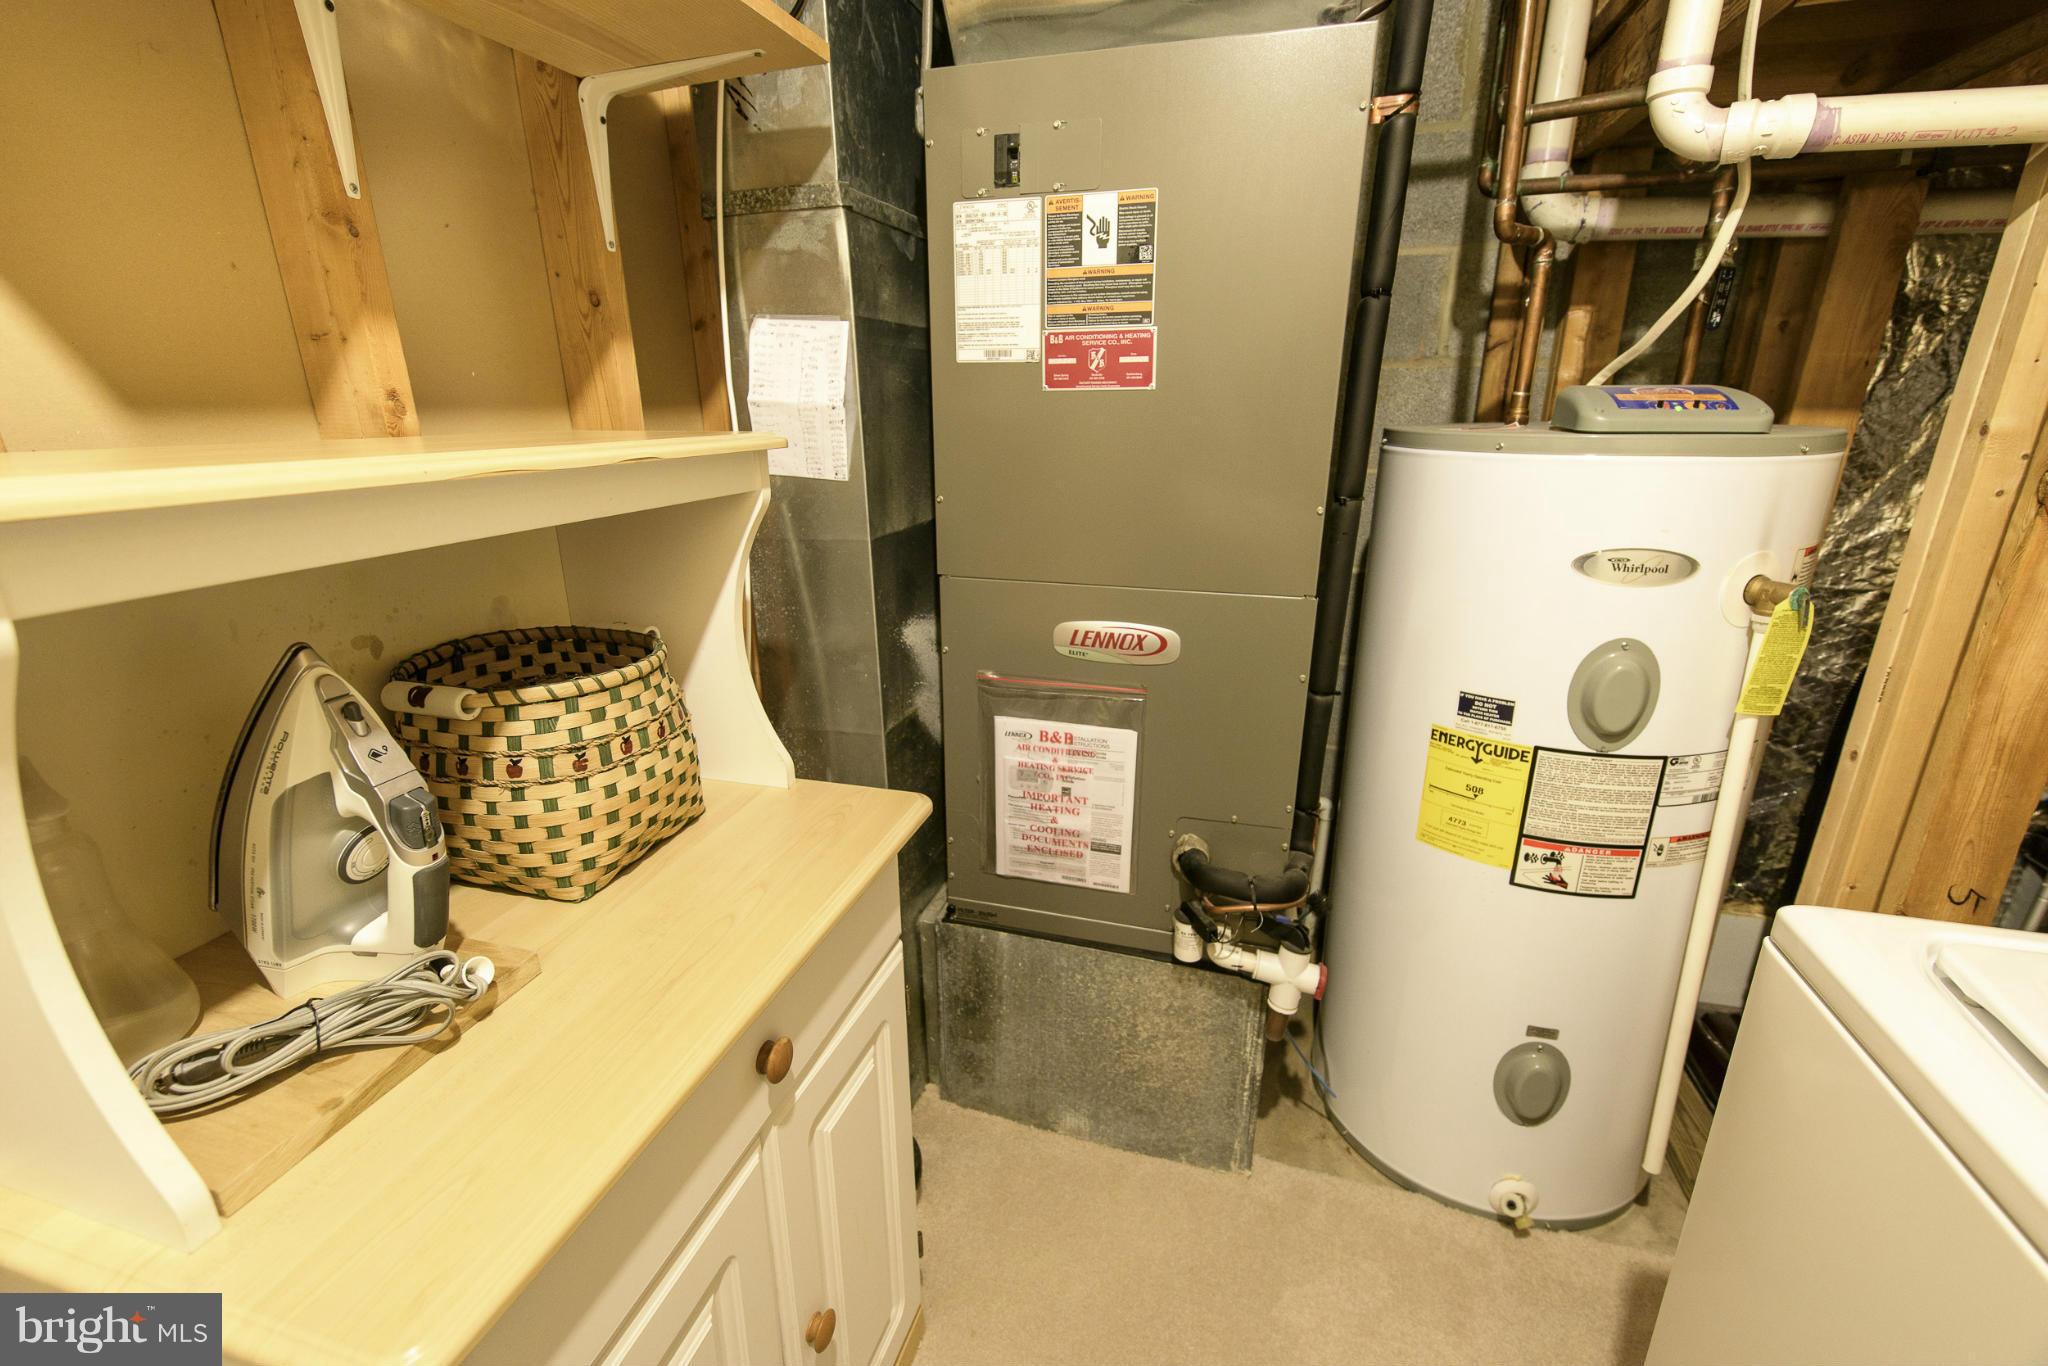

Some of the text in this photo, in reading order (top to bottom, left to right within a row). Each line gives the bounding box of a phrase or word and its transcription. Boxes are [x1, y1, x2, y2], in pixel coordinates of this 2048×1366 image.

[1842, 133, 1871, 145] ASTM
[1125, 193, 1155, 201] WARNING
[1088, 267, 1115, 275] WARNING
[1075, 333, 1118, 341] CONDITIONING
[1611, 562, 1670, 576] Whirlpool
[1069, 628, 1148, 652] LENNOX
[1484, 702, 1497, 710] NOT
[1040, 730, 1073, 746] B&B
[1016, 743, 1031, 752] AIR
[1430, 728, 1531, 764] ENERGYGUIDE
[1018, 761, 1055, 771] HEATING
[1465, 783, 1484, 796] 508
[1022, 790, 1089, 805] IMPORTANT
[1030, 802, 1081, 817] HEATING
[1050, 816, 1059, 825] &
[1030, 824, 1081, 838] COOLING
[1021, 833, 1089, 849] DOCUMENTS
[1027, 845, 1084, 860] ENCLOSED
[1571, 846, 1612, 856] DANGER
